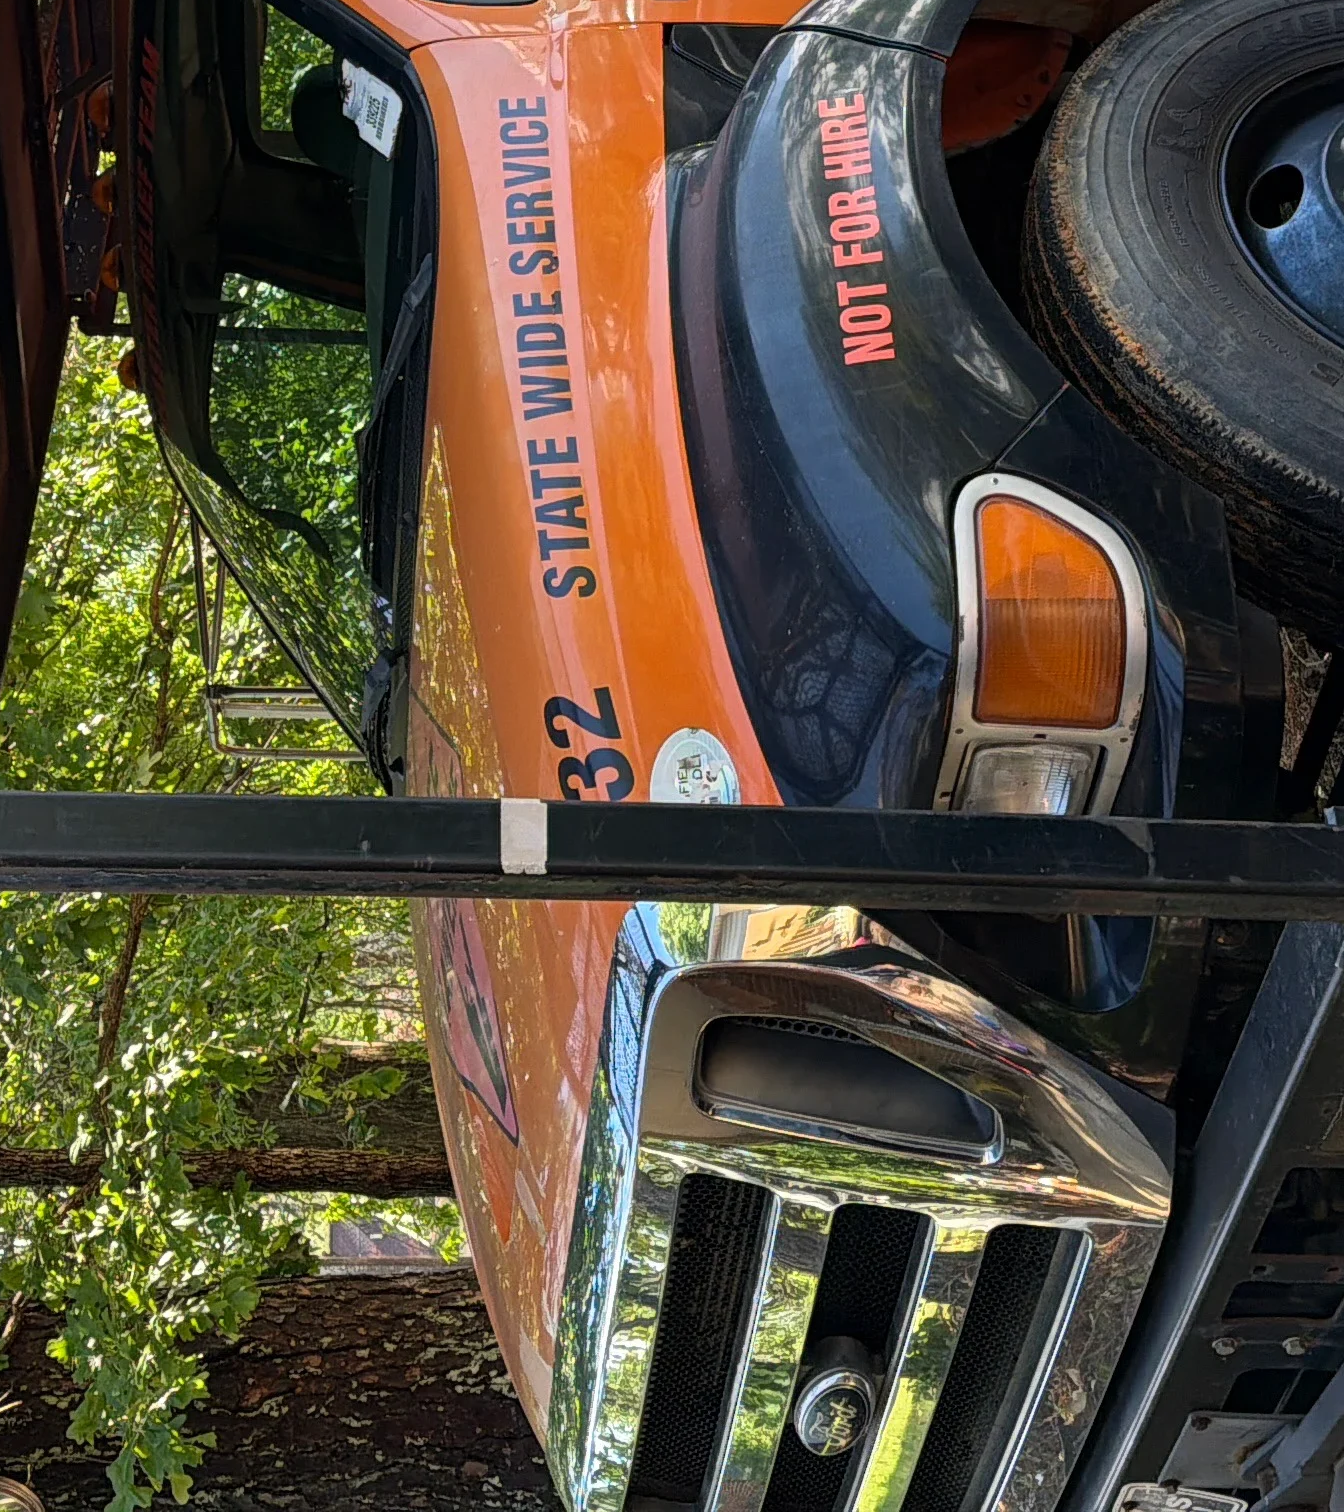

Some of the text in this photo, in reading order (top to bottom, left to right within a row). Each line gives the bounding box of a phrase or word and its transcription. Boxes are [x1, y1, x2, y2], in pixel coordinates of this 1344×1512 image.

[137, 37, 161, 154] TEAM
[136, 157, 155, 293] RELIEF
[817, 93, 896, 366] NOT FOR HIRE
[498, 95, 597, 599] STATE WIDE SERVICE
[808, 1396, 858, 1447] Ford
